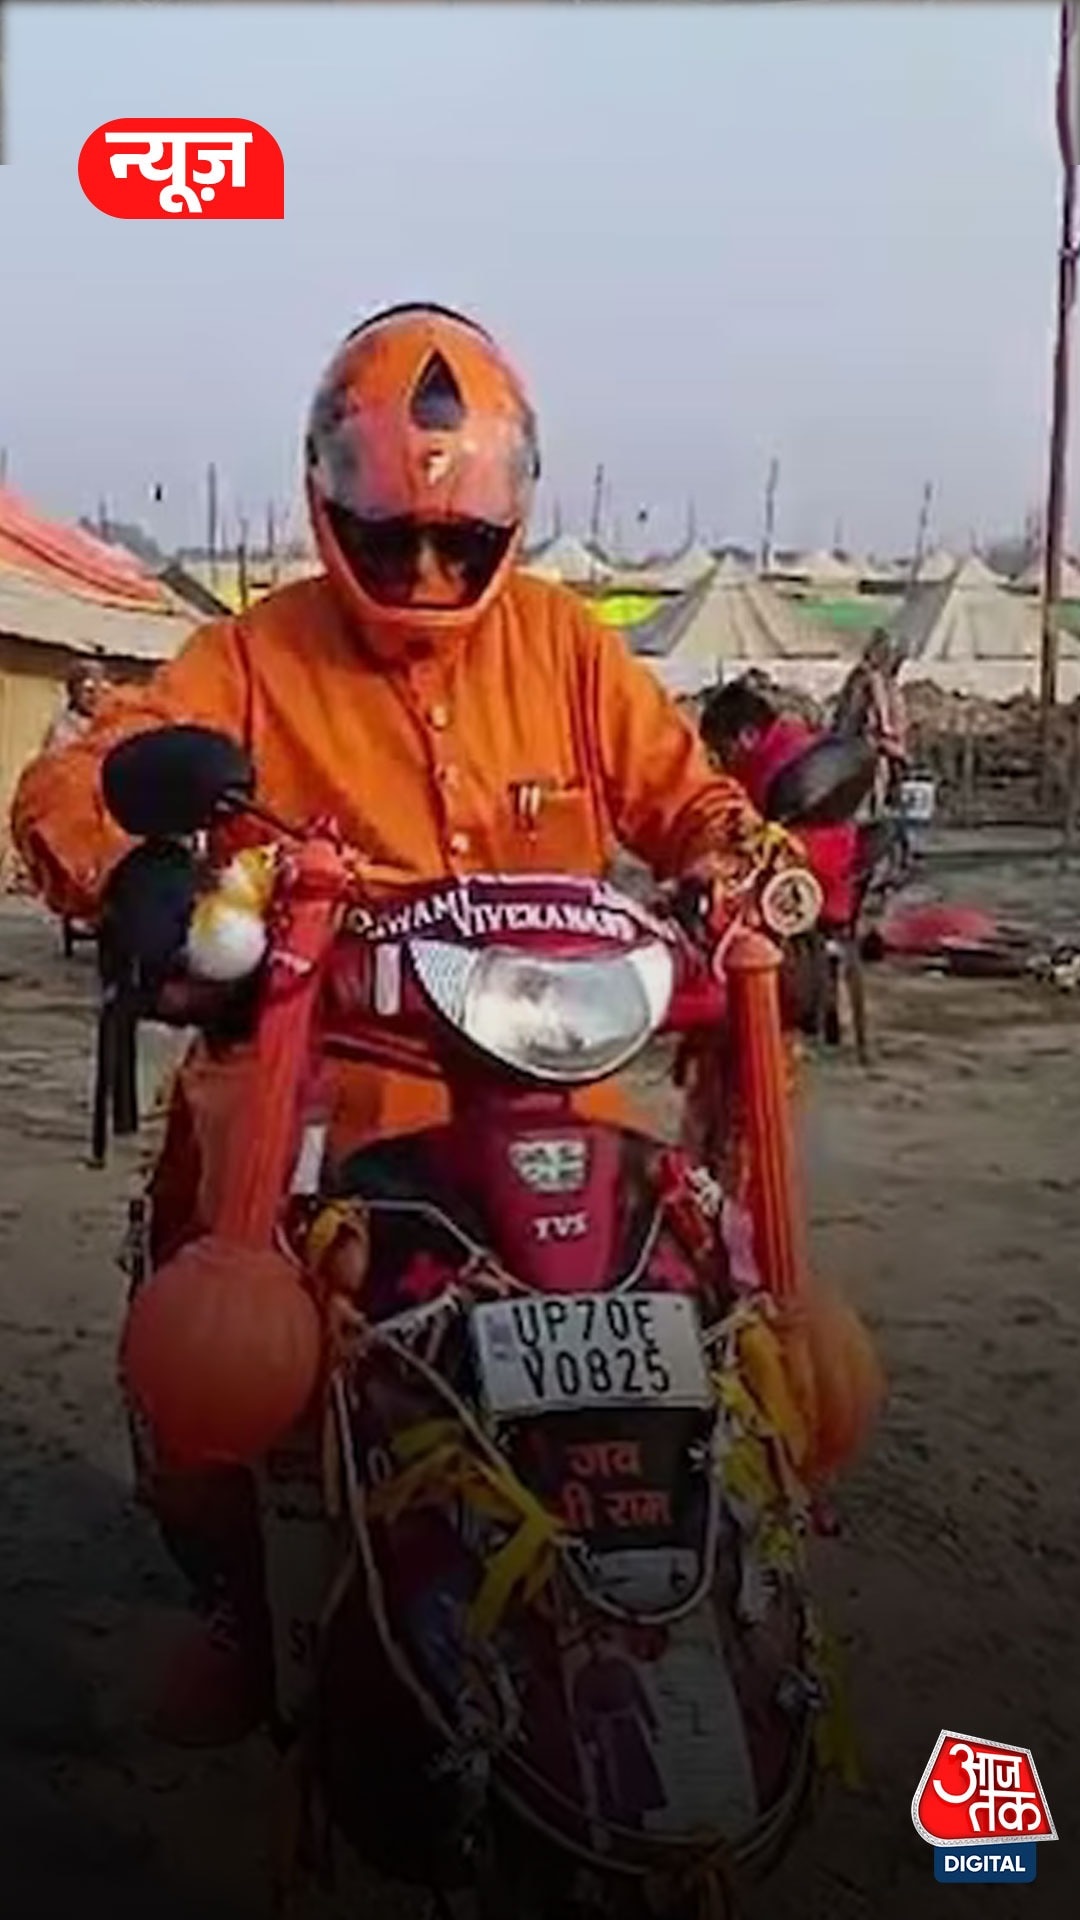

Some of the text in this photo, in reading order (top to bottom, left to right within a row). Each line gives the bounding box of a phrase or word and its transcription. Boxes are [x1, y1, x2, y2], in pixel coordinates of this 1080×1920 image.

[532, 1211, 589, 1240] TVS
[512, 1300, 656, 1347] UP70E
[521, 1348, 670, 1398] V0825
